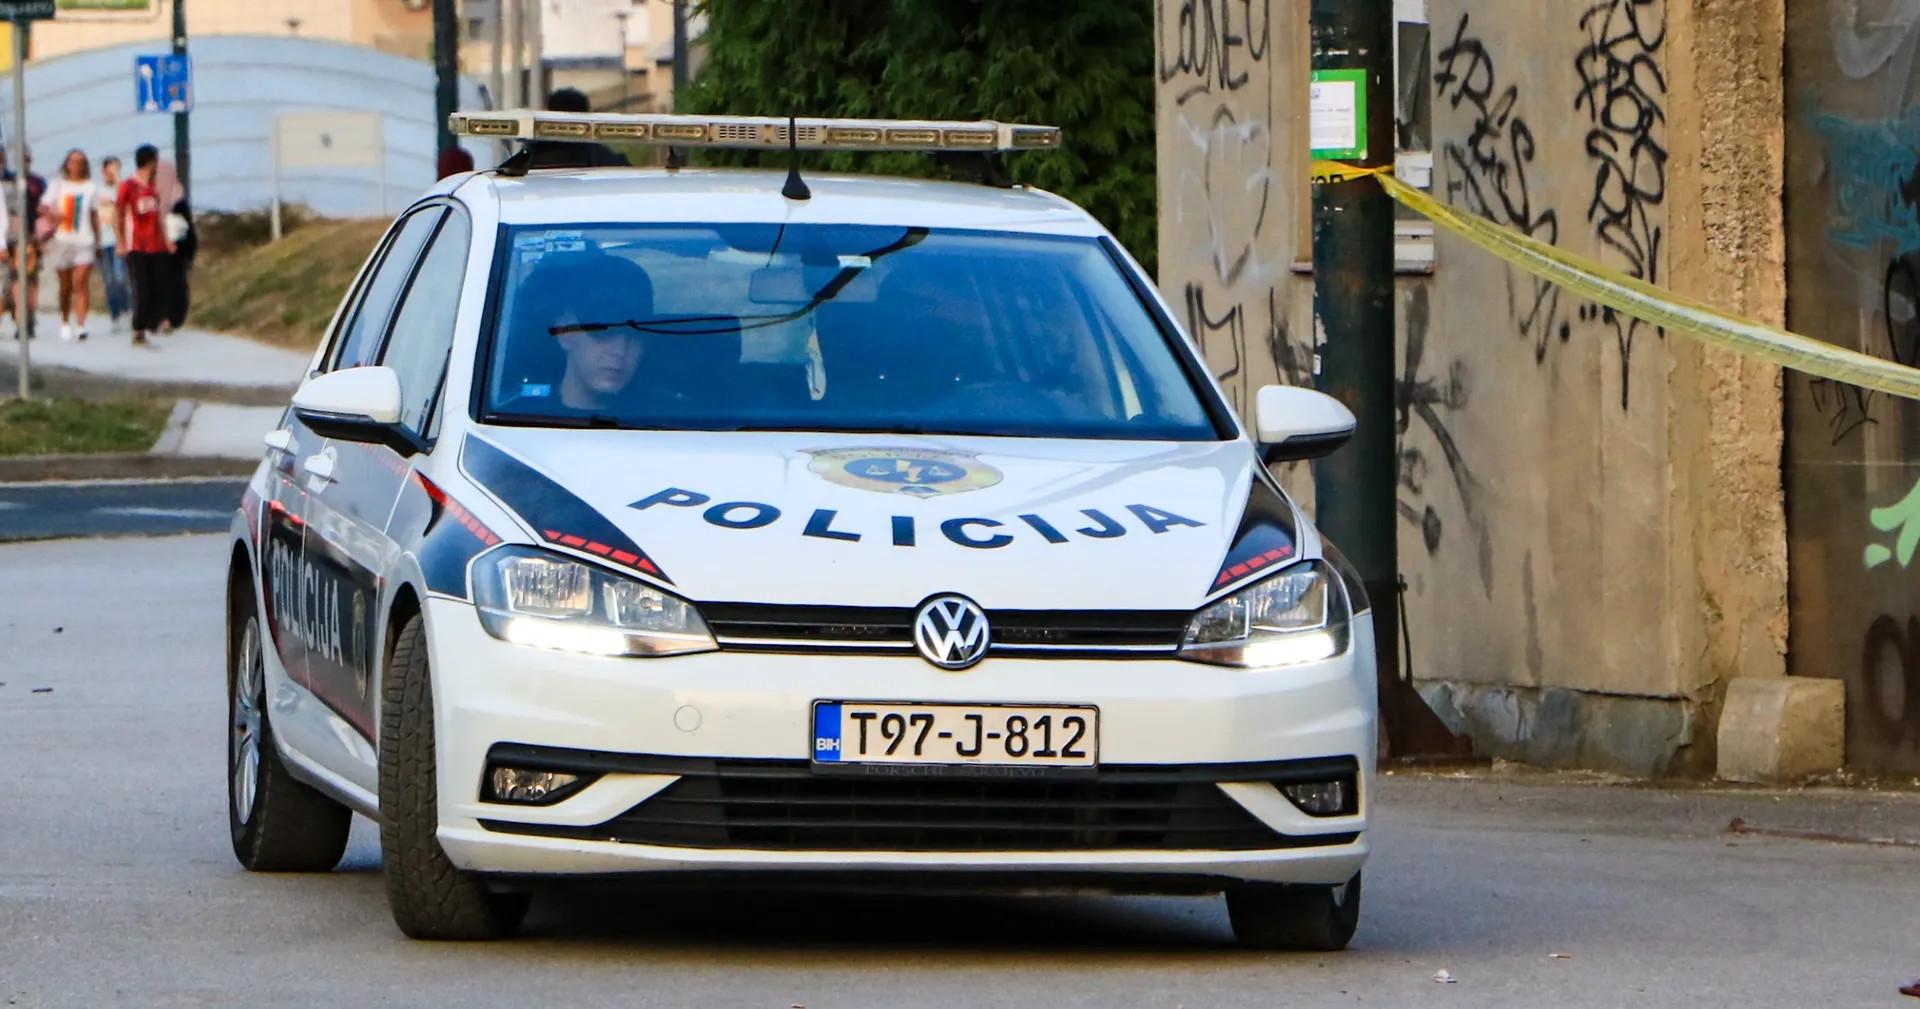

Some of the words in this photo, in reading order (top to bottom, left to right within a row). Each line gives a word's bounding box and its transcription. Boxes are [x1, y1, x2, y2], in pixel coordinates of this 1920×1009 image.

[629, 486, 1207, 549] POLICIJA
[272, 537, 344, 668] POLICIJA
[917, 596, 988, 667] VW
[815, 737, 840, 751] BIH
[850, 711, 1087, 759] T97-J-812
[865, 765, 946, 777] PORSCHE
[954, 765, 1046, 778] SARAJEVO
